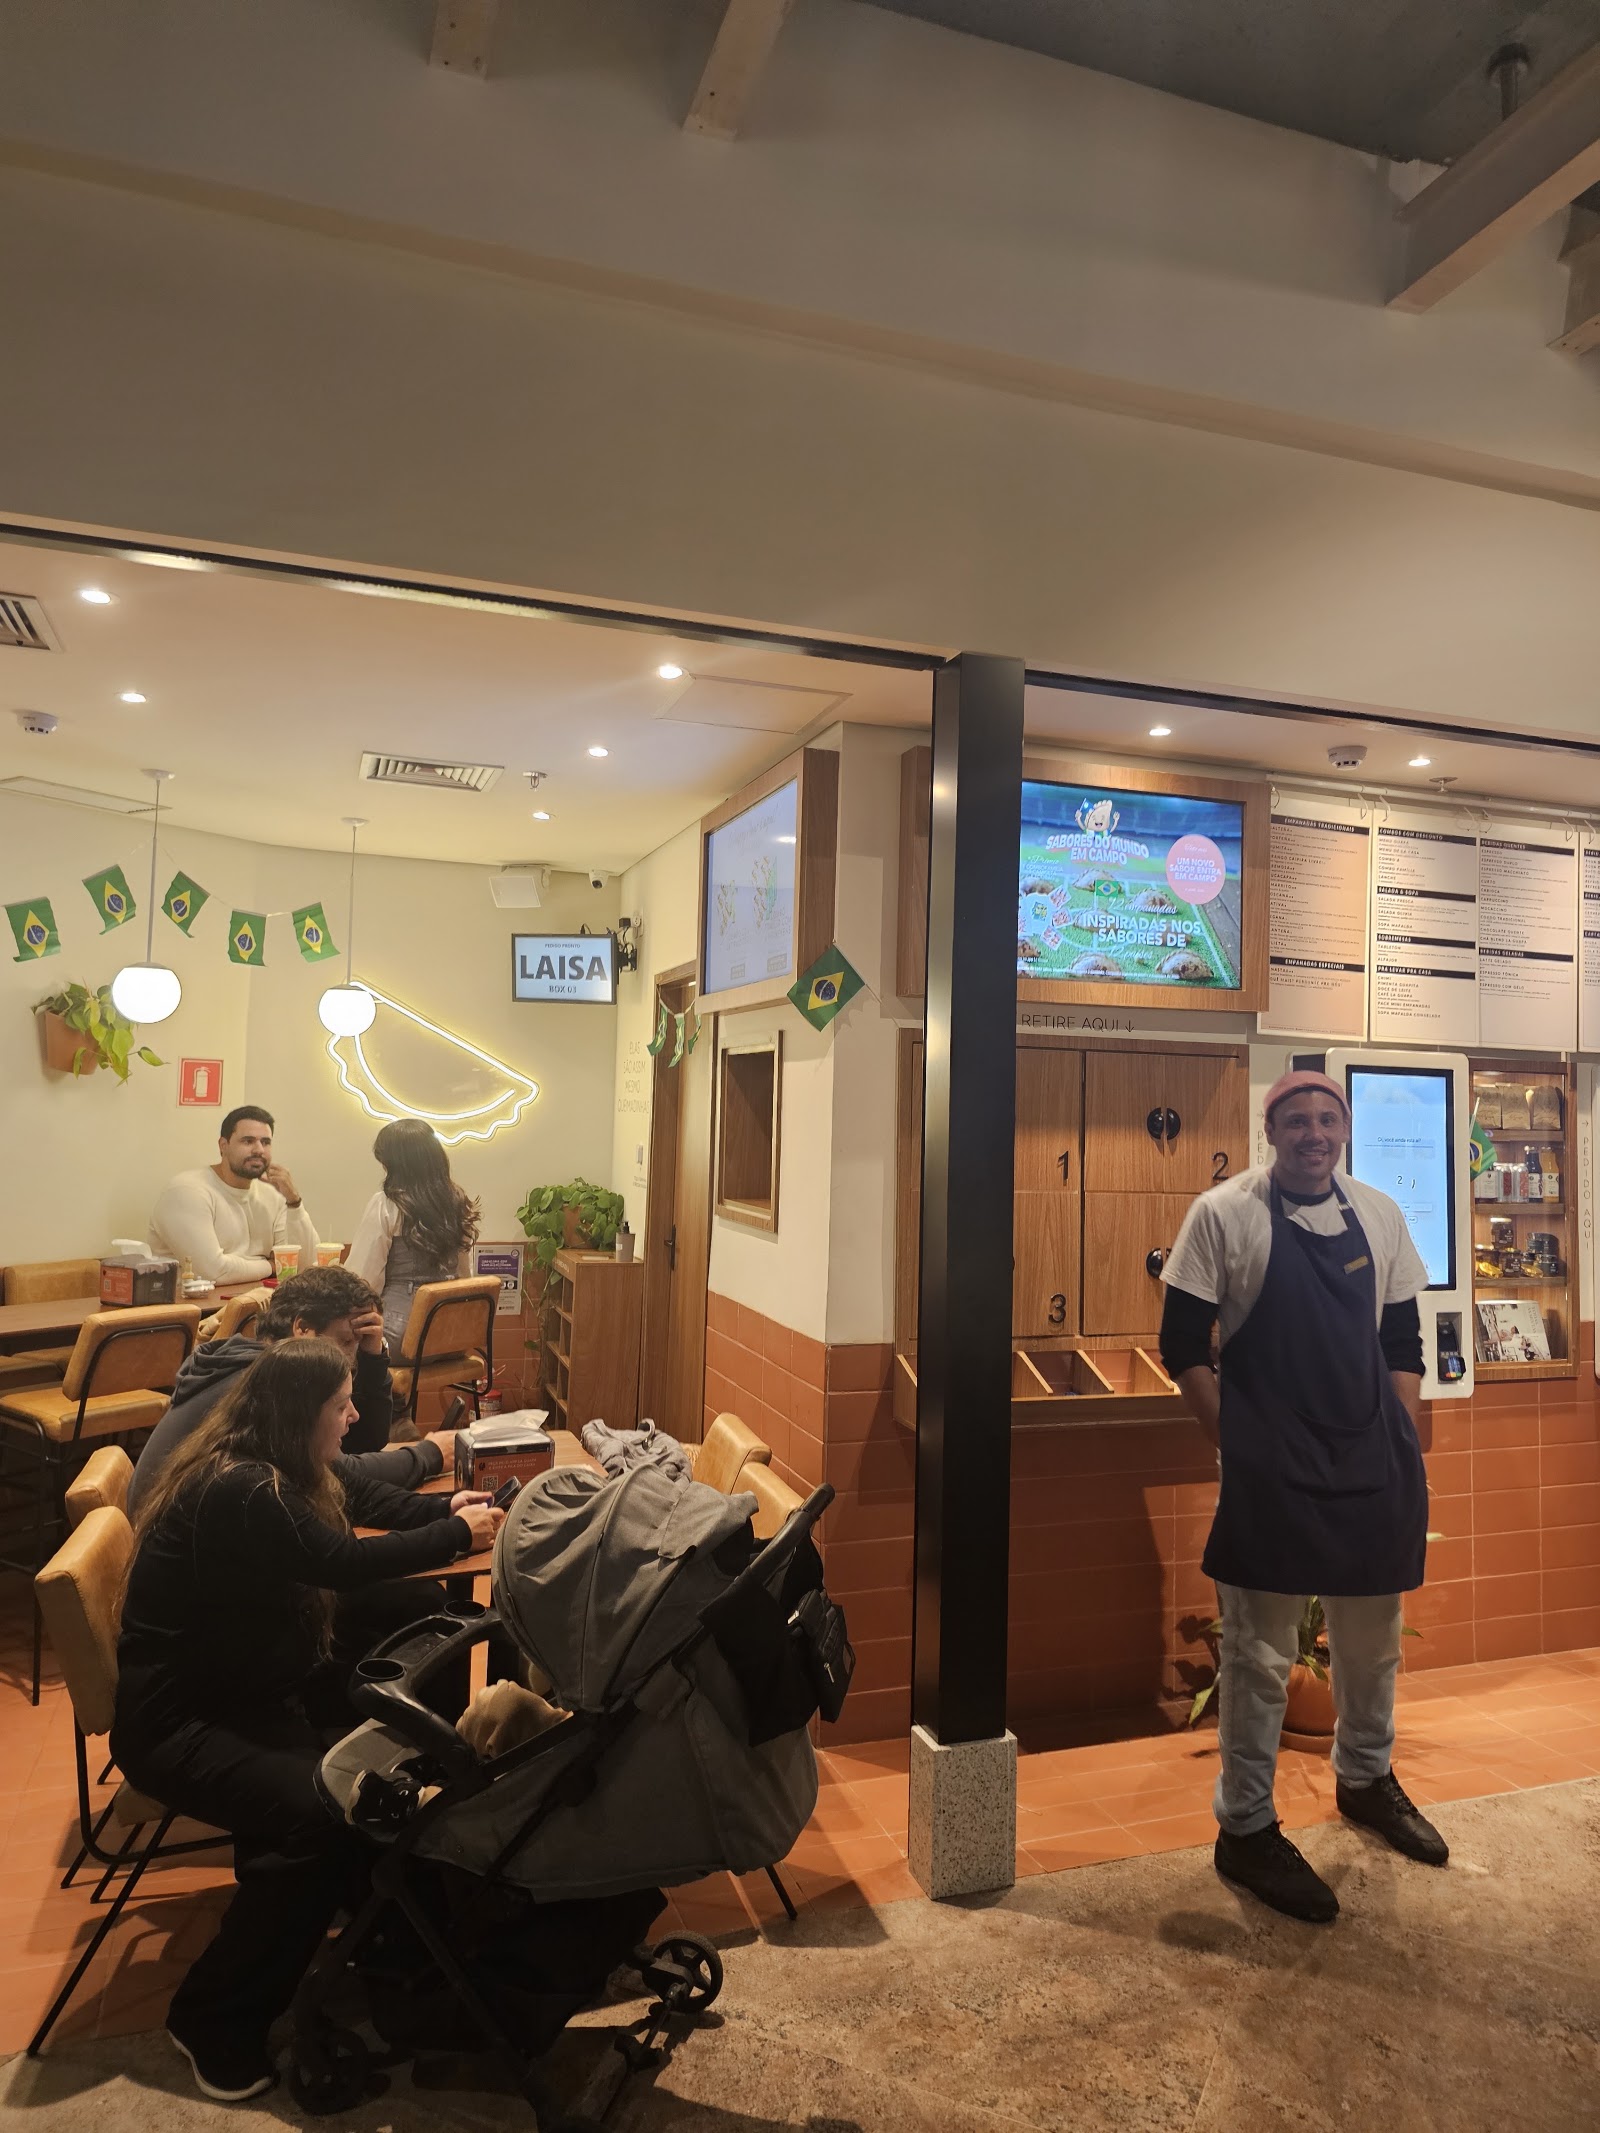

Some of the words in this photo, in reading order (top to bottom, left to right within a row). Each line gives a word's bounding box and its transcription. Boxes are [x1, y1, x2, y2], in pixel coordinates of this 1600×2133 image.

[1045, 833, 1094, 850] SABORES
[1095, 835, 1111, 848] DO
[1111, 837, 1150, 859] MUNDO
[1071, 847, 1087, 860] EM
[1088, 848, 1127, 865] CAMPO
[1176, 857, 1190, 865] UM
[1191, 858, 1215, 868] NOVO
[1169, 864, 1195, 873] SABOR
[1196, 866, 1222, 875] ENTRA
[1174, 872, 1187, 880] EM
[1188, 873, 1217, 883] CAMPO
[1108, 898, 1124, 910] 12
[1124, 901, 1178, 914] empanadas
[1083, 914, 1167, 933] INSPIRADAS
[1171, 919, 1201, 935] NOS
[1098, 929, 1163, 946] SABORES
[1166, 933, 1187, 948] DE
[520, 954, 608, 981] LAISA
[549, 985, 565, 993] BOX
[1021, 1014, 1076, 1030] RETIRE
[1082, 1016, 1119, 1032] AQUI
[1257, 1130, 1265, 1165] PED
[1057, 1150, 1070, 1182] 1
[1212, 1152, 1229, 1181] 2
[1048, 1293, 1067, 1324] 3
